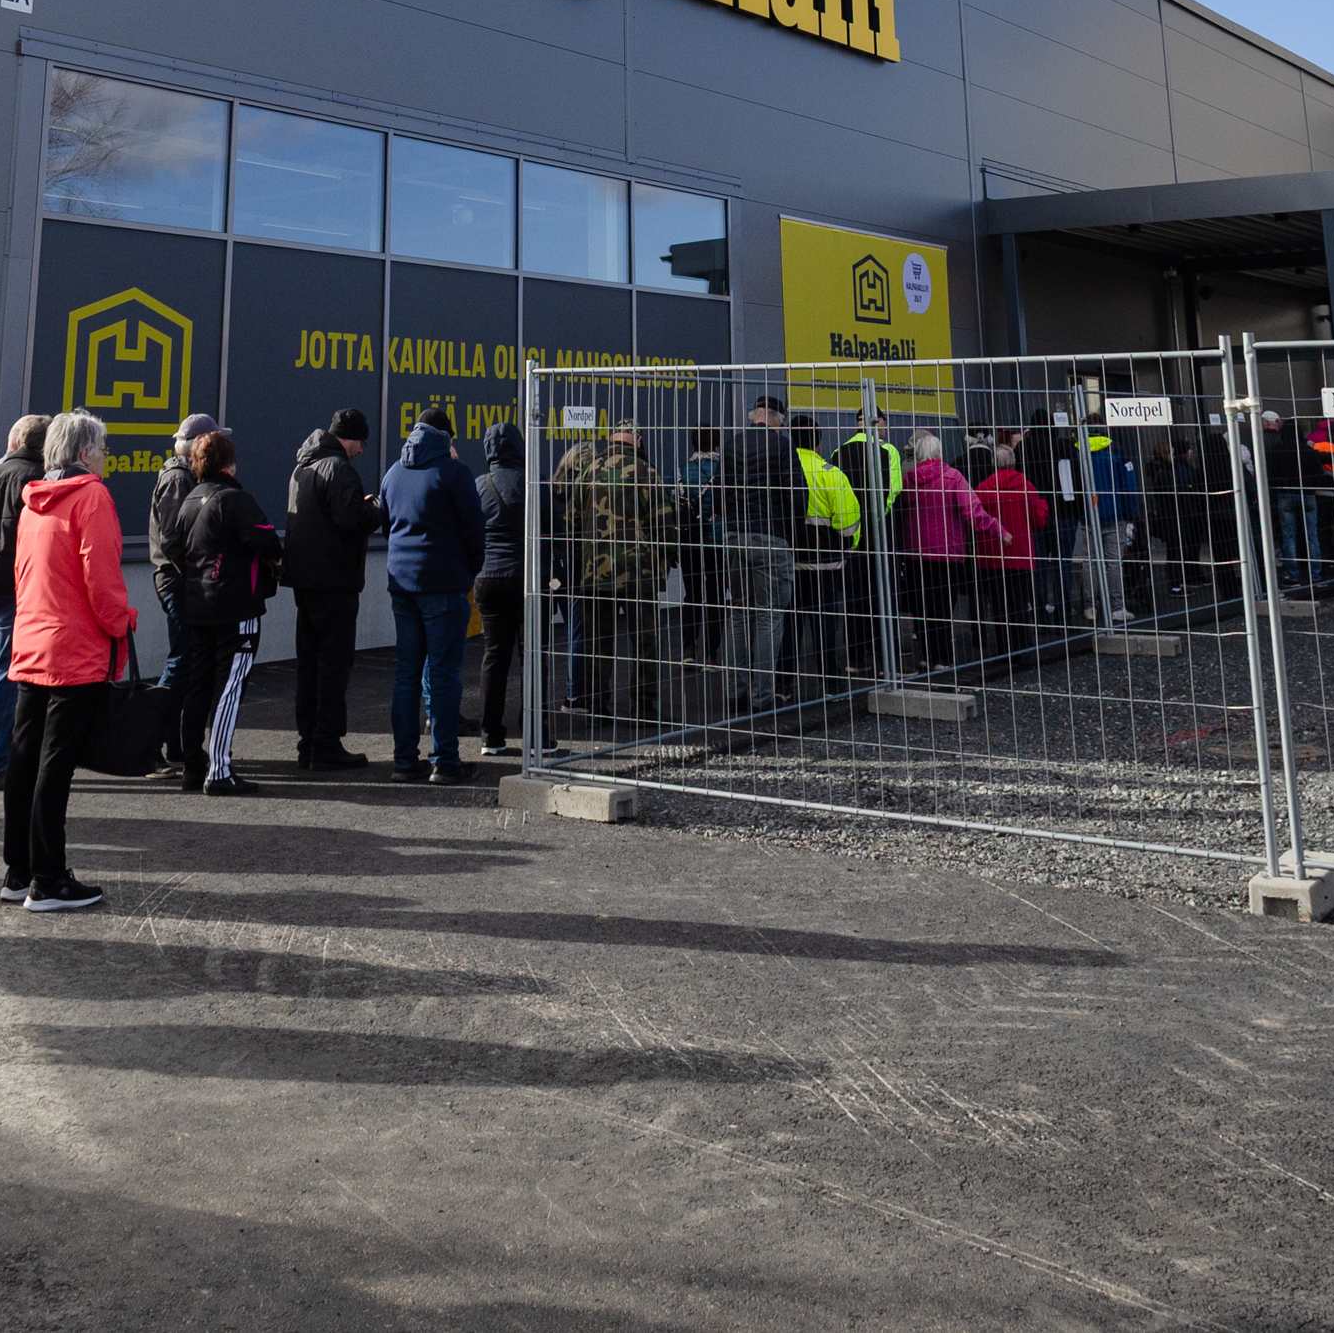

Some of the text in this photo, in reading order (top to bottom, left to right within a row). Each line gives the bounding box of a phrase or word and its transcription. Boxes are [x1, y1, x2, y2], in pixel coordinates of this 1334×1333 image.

[295, 329, 374, 372] JOTTA
[388, 336, 486, 378] KAIKILLA
[830, 332, 917, 362] HalpaHalli
[567, 408, 594, 425] Nordpel
[1109, 401, 1164, 422] Nordpel
